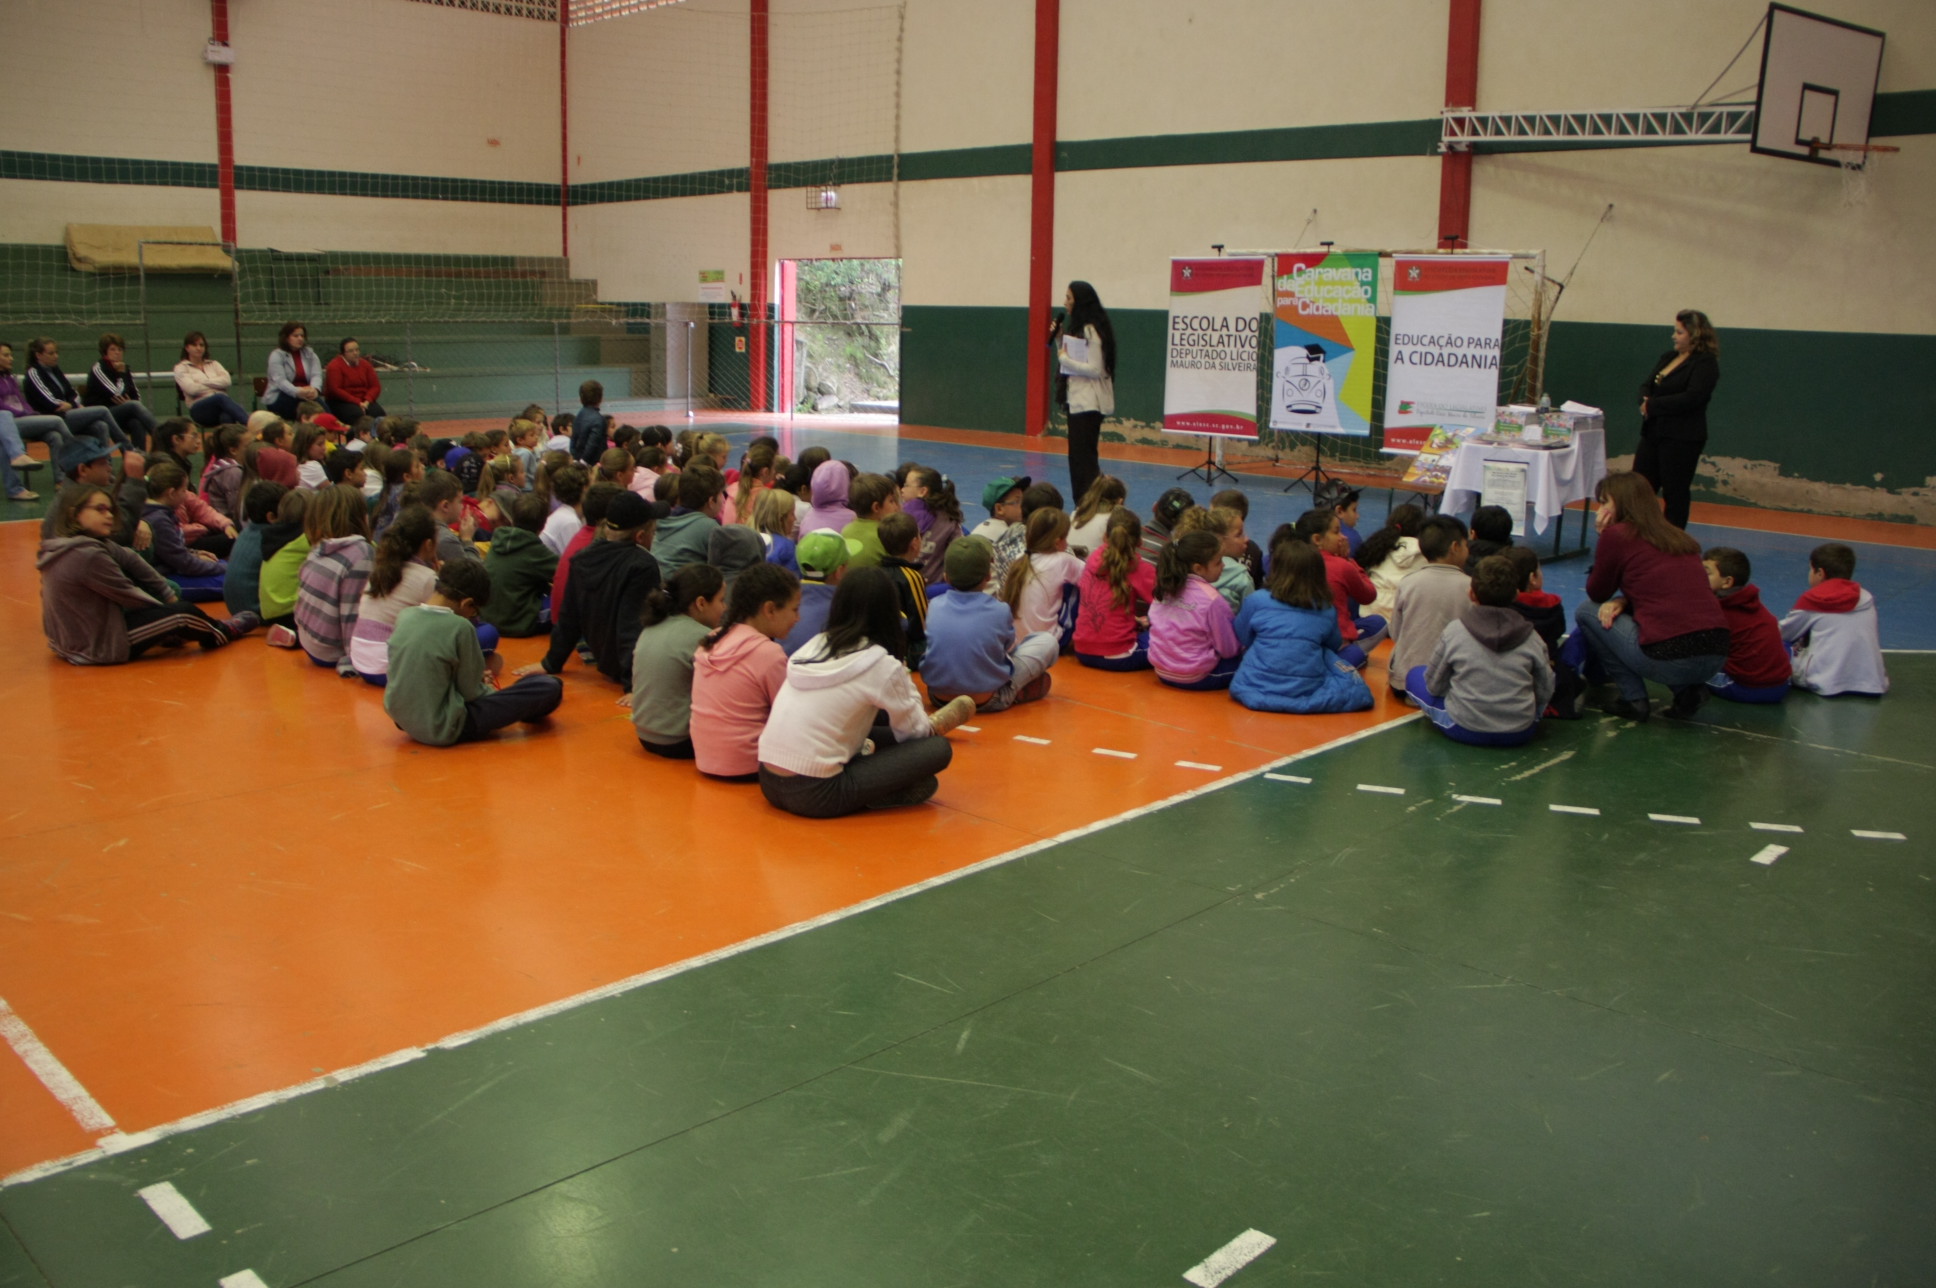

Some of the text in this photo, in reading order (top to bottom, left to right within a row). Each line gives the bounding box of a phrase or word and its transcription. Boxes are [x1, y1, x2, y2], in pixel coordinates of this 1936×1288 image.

[1293, 263, 1372, 281] Caravana
[1295, 281, 1372, 299] Educação
[1277, 297, 1298, 307] para
[1298, 298, 1375, 315] Cidadania
[1172, 315, 1260, 333] ESCOLA DO
[1171, 332, 1259, 349] LEGISLATIVO
[1394, 333, 1500, 350] EDUCAÇÃO PARA
[1170, 347, 1258, 362] DEPUTADO LÍCIO
[1394, 350, 1499, 370] A CIDADANIA
[1170, 360, 1257, 372] MAURO DA SILVEIRA
